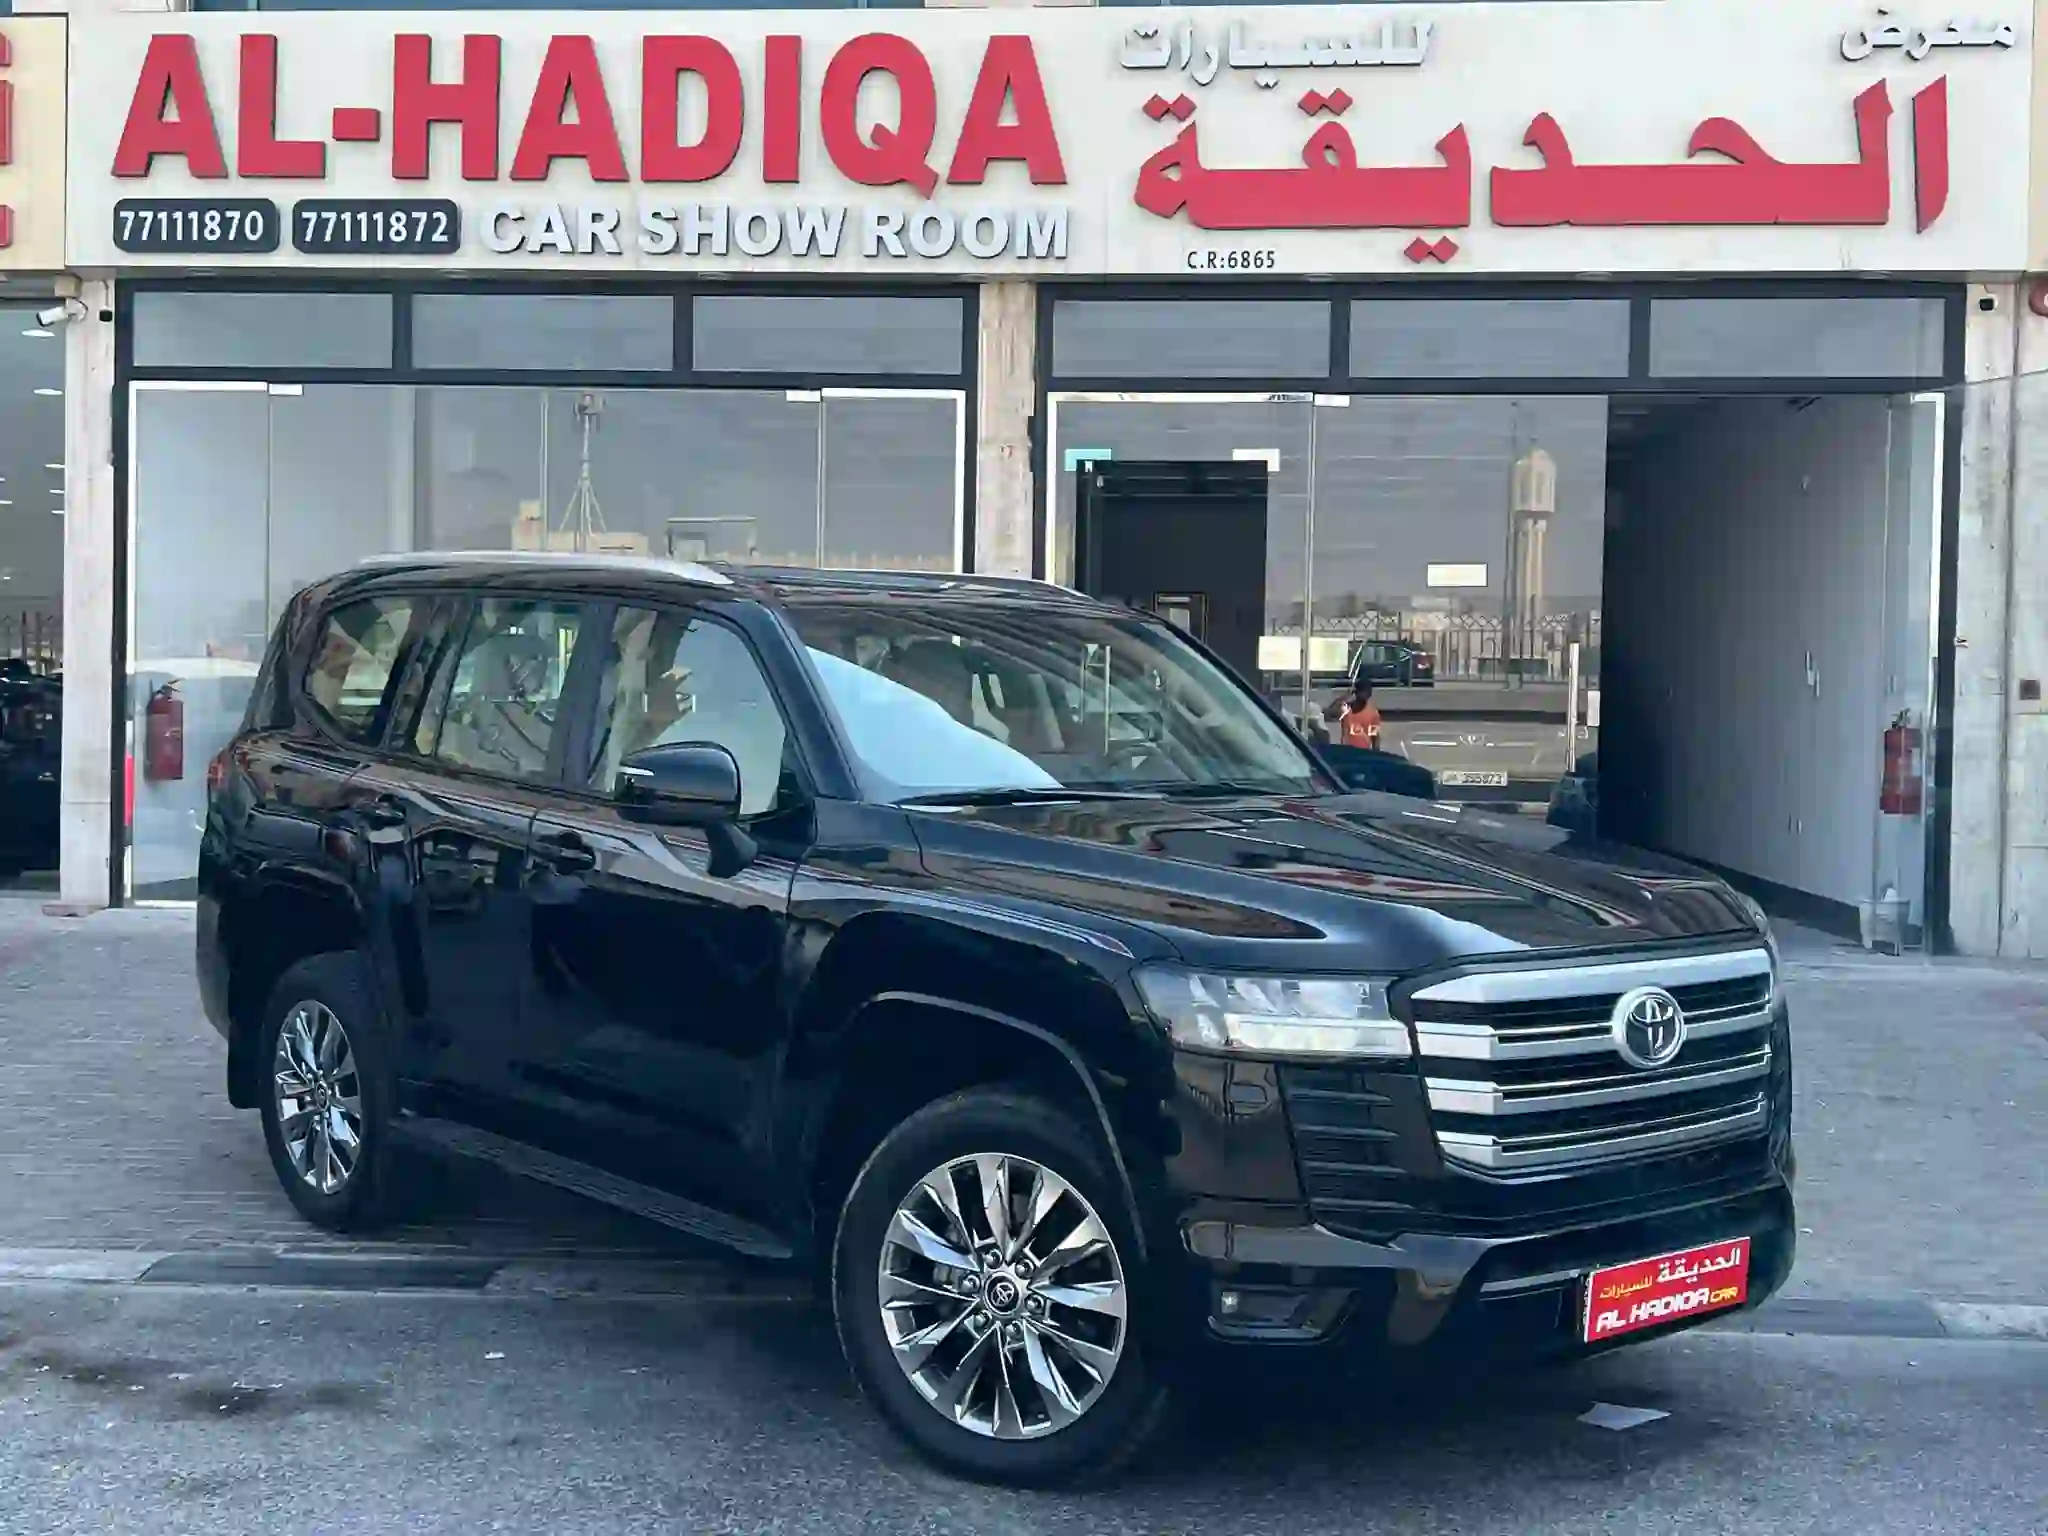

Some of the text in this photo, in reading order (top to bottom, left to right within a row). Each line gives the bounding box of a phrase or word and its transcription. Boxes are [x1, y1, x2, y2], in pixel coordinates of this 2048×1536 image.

[1840, 8, 2016, 61] معرض
[1119, 22, 1434, 88] للسيارات
[111, 33, 1068, 199] AL-HADIQA
[1134, 74, 1950, 264] الحديقة
[119, 210, 264, 242] 77111870
[301, 211, 449, 243] 77111872
[482, 204, 1069, 259] CAR SHOW ROOM
[1187, 250, 1276, 270] C.R:6865
[1657, 1248, 1741, 1282] الحديقة
[1600, 1274, 1653, 1299] للسيارات
[1596, 1310, 1627, 1333] AL
